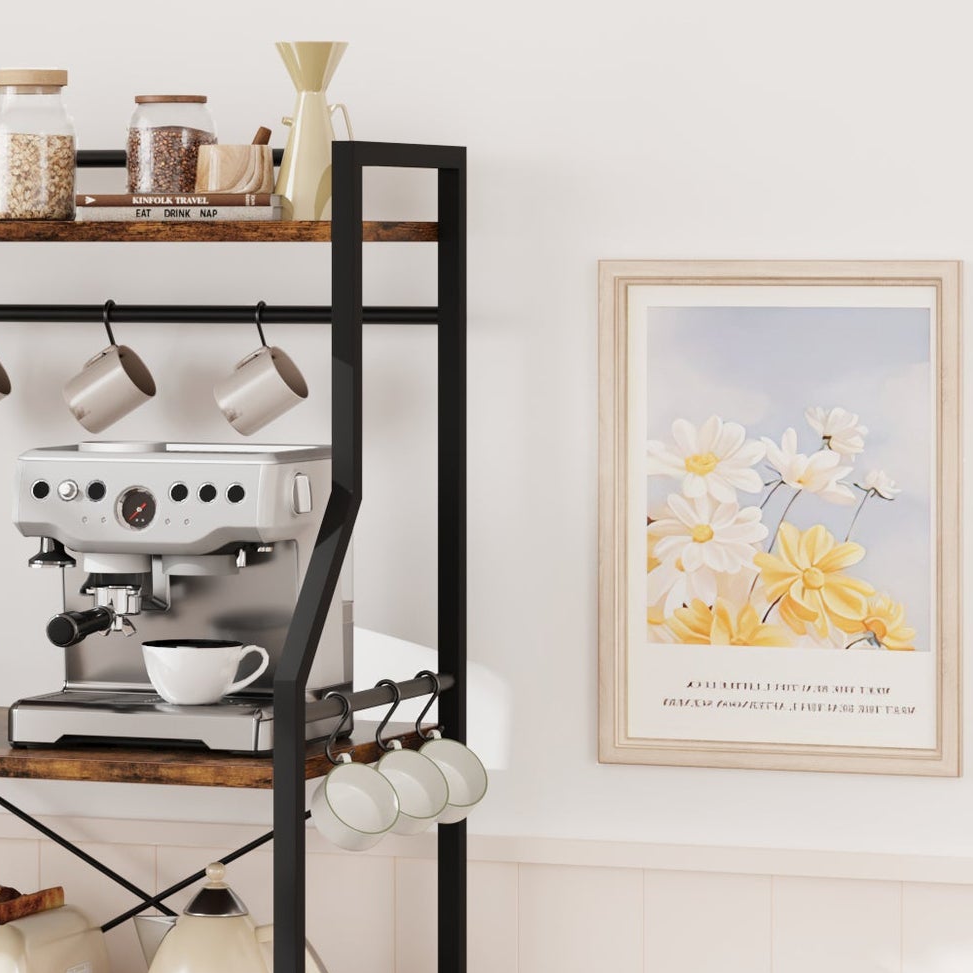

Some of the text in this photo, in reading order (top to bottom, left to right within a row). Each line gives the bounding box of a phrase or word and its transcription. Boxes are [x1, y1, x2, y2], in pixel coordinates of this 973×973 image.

[132, 196, 209, 205] KINFOLK TRAVEL
[135, 209, 217, 218] EAT DRINK NAP
